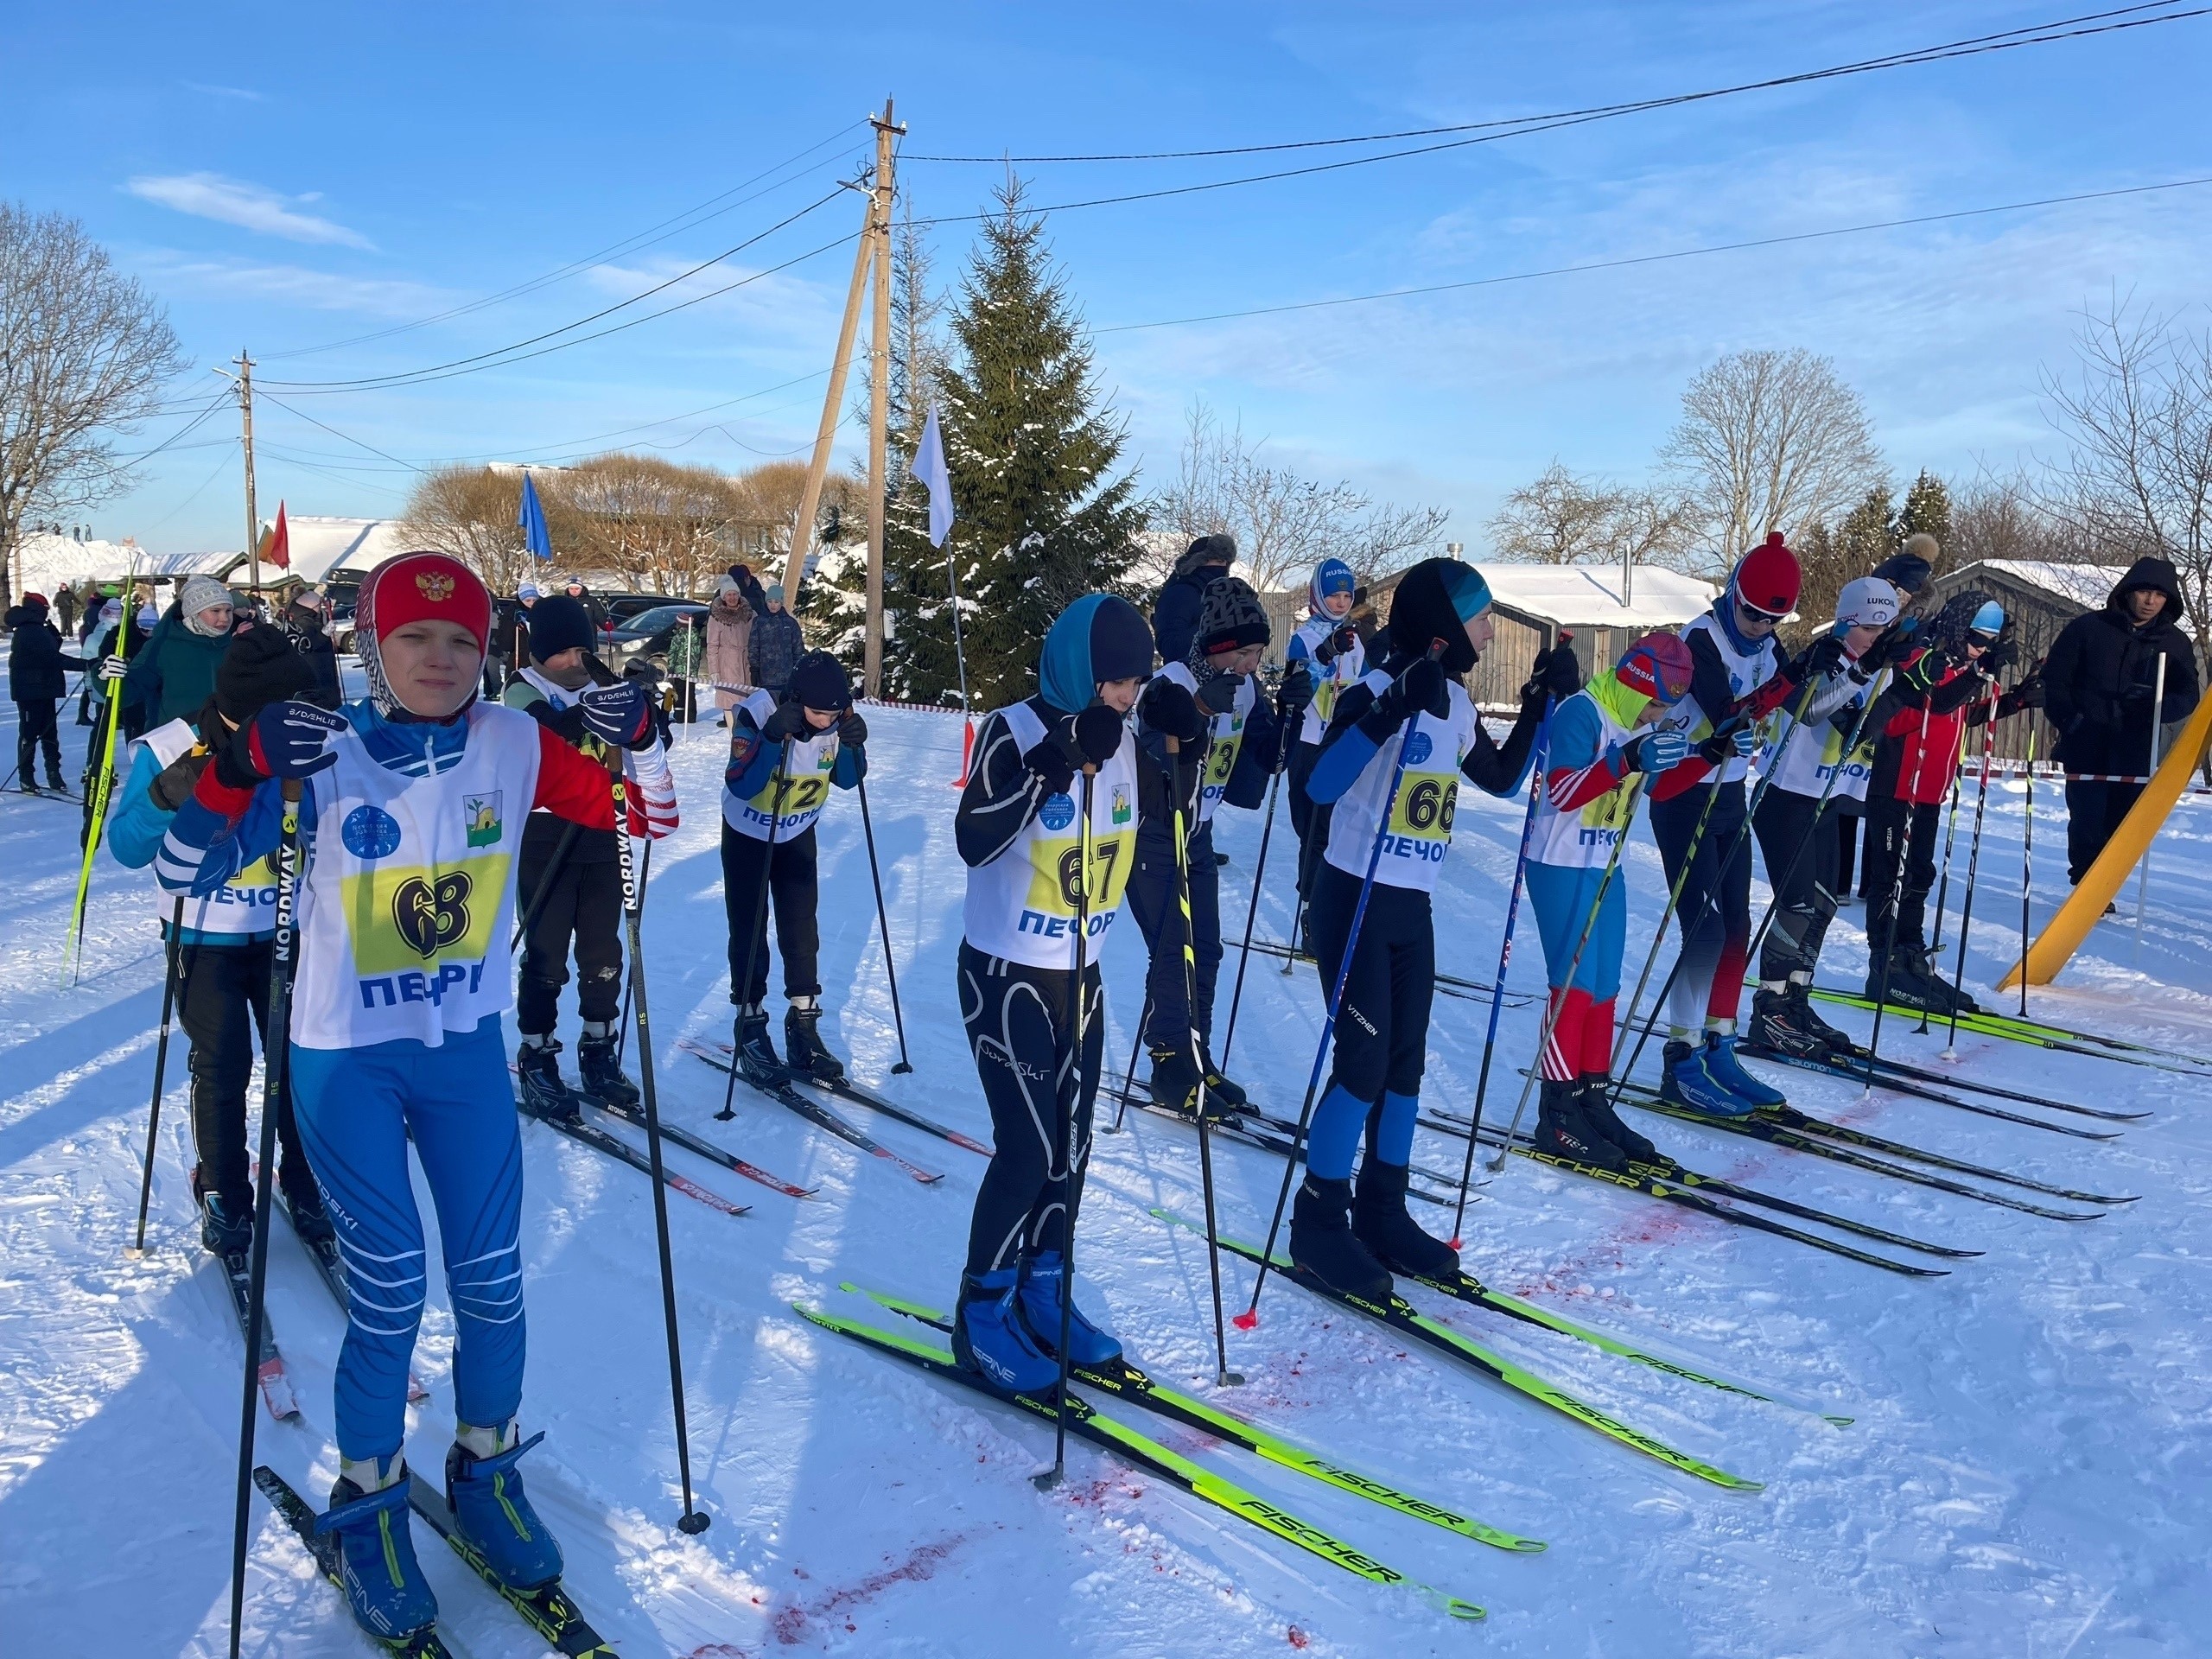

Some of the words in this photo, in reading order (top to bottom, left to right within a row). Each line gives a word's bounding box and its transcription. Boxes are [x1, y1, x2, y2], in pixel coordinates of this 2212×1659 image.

[1867, 597, 1895, 607] LUKOIL
[1626, 661, 1656, 683] RUSSIA
[95, 766, 111, 818] FISCHER
[1405, 779, 1459, 834] 66
[614, 809, 638, 911] NORDWAY
[1057, 839, 1120, 908] 67
[275, 843, 296, 962] NORDWAY
[391, 870, 474, 961] 68
[639, 1012, 646, 1026] RS
[1347, 1004, 1378, 1036] VITZHEN
[812, 1077, 833, 1090] ATOMIC
[1788, 1058, 1832, 1073] salomon
[607, 1103, 628, 1118] ATOMIC
[1678, 1080, 1738, 1112] SPINE
[1177, 1113, 1218, 1132] saloon
[1510, 1147, 1641, 1190] FISCHER
[1414, 1274, 1459, 1296] FISCHER
[1344, 1294, 1387, 1317] FISCHER
[972, 1344, 1017, 1384] SPINE
[1073, 1368, 1122, 1392] FISCHER
[1544, 1391, 1690, 1463] FISCHER
[1303, 1460, 1465, 1527] FISCHER
[1239, 1501, 1402, 1584] FISCHER
[447, 1533, 559, 1644] FISCHER
